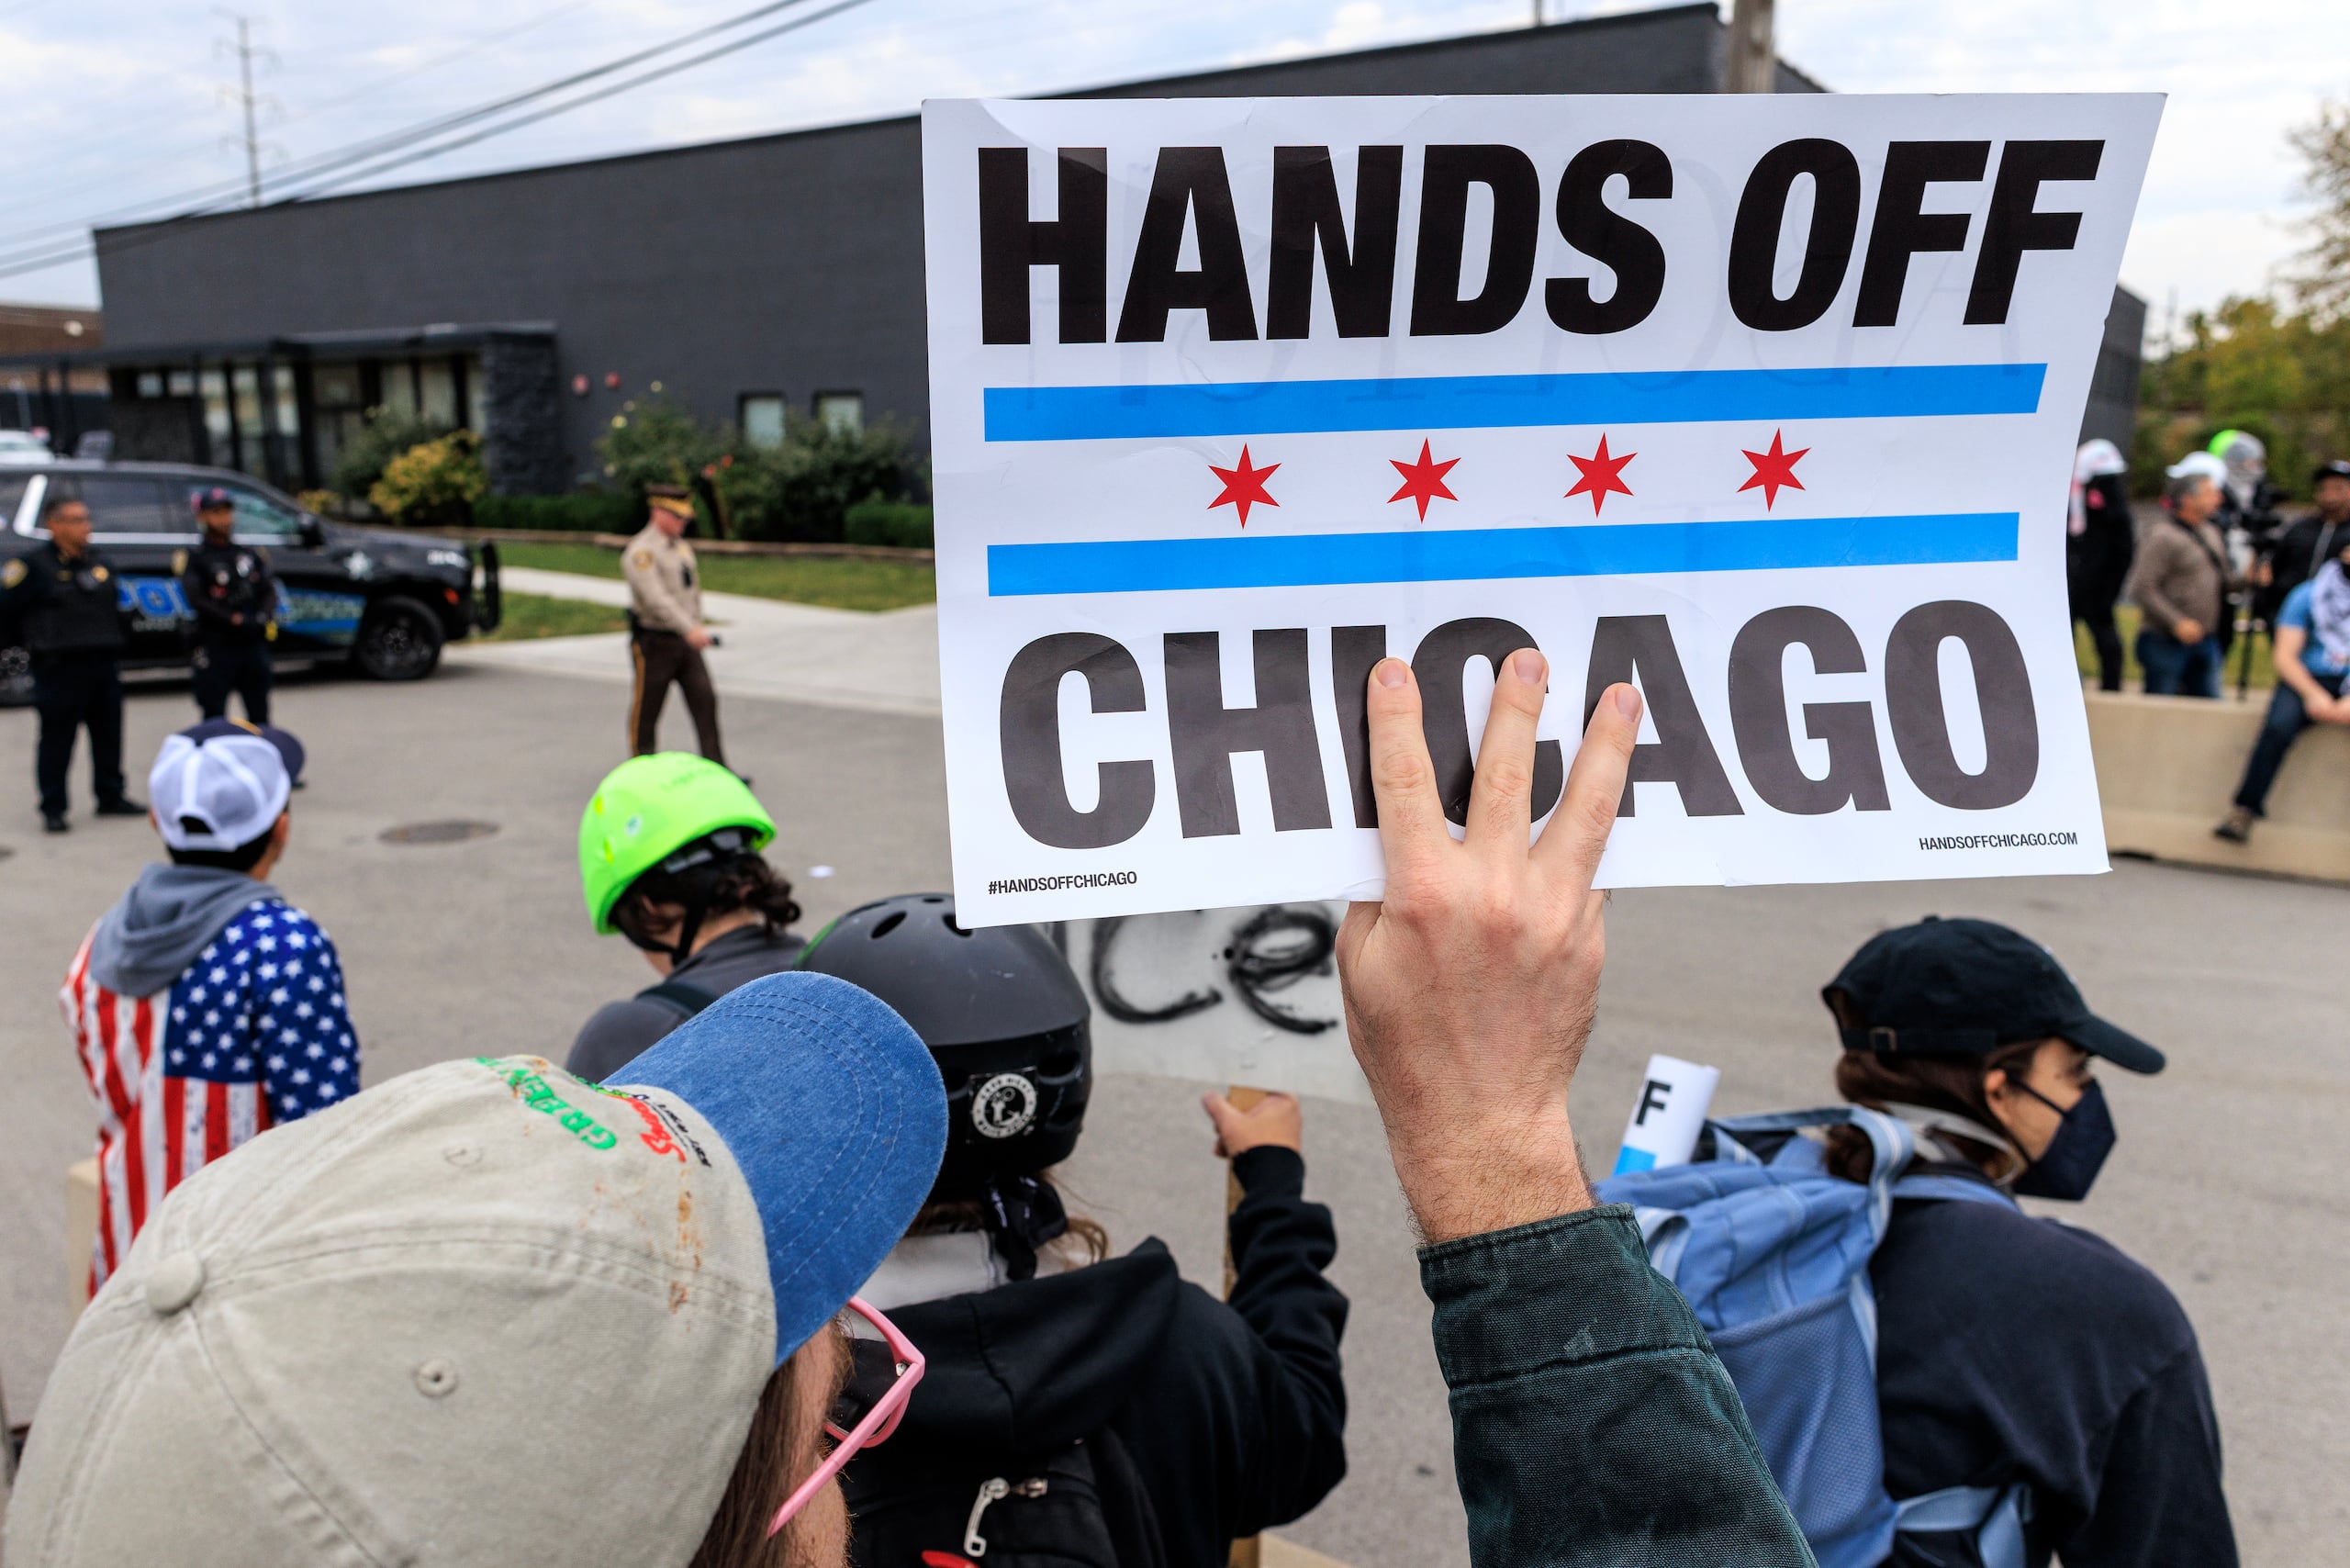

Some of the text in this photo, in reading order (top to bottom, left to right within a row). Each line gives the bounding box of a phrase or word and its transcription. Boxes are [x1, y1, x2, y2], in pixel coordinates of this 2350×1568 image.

[979, 139, 2105, 344] HANDS OFF
[1001, 600, 2038, 848] CHICAGO
[988, 870, 1137, 895] #HANDSOFFCHICAGO
[1919, 832, 2078, 850] HANDSOFFCHICAGO.COM
